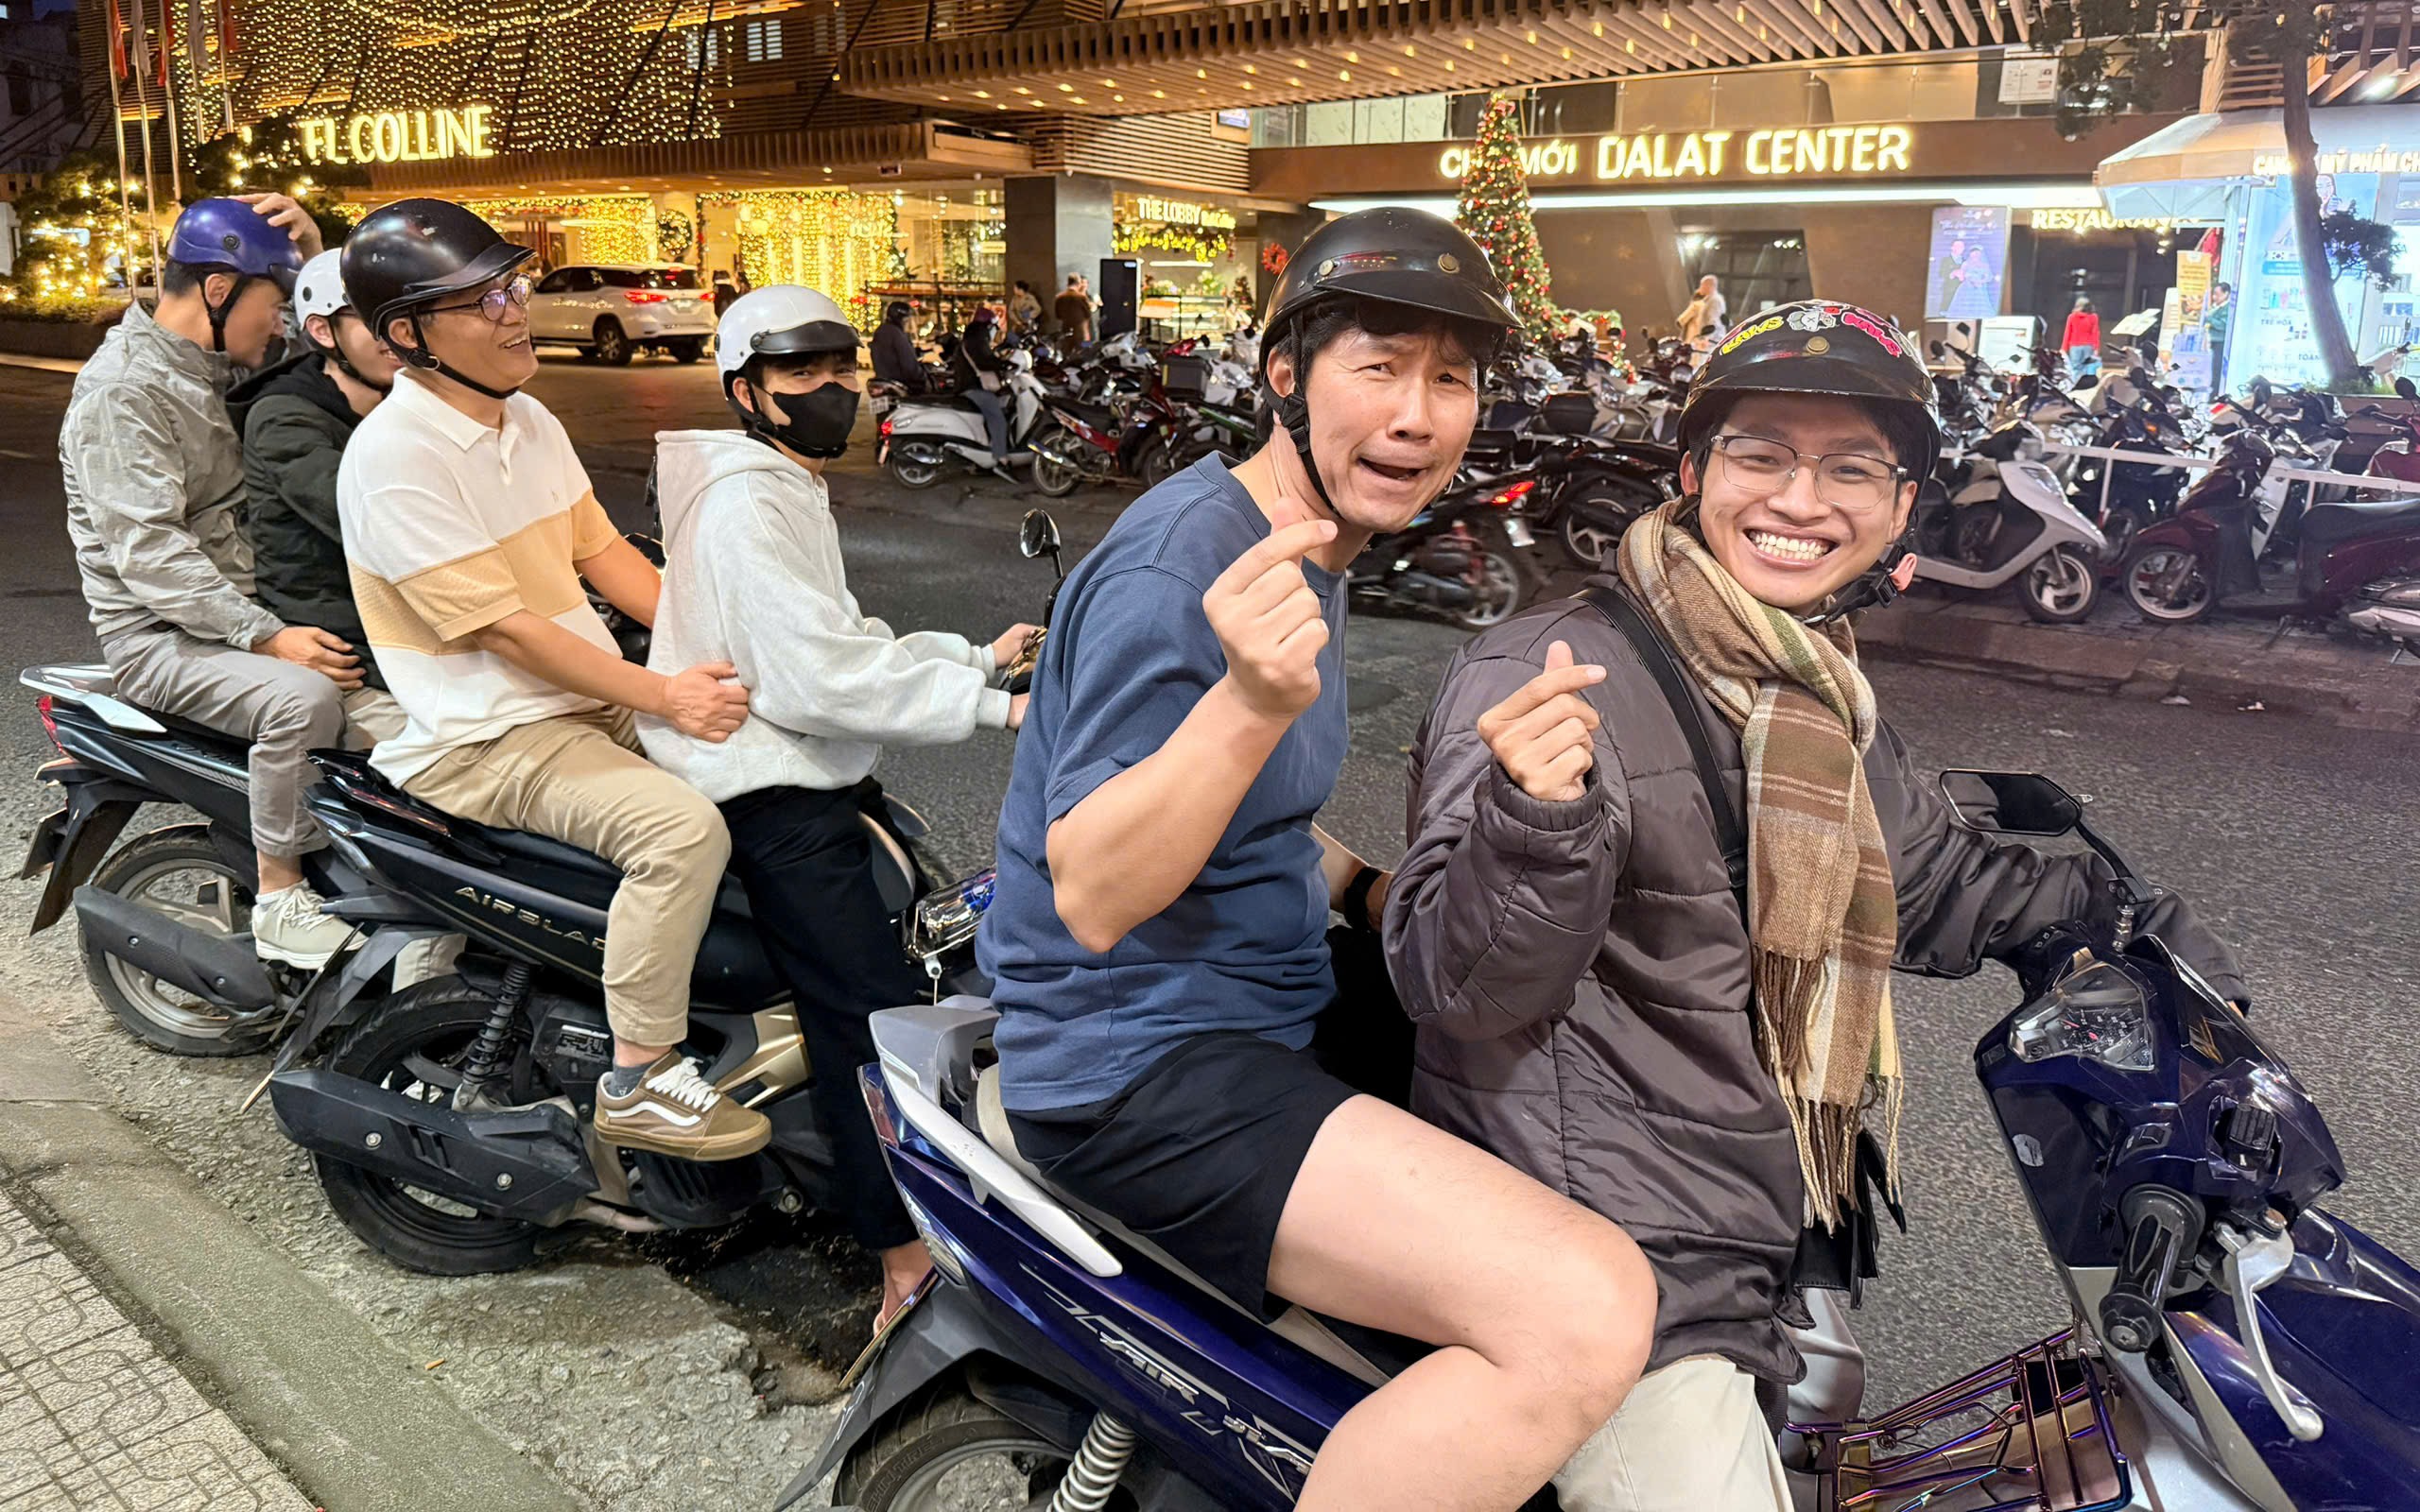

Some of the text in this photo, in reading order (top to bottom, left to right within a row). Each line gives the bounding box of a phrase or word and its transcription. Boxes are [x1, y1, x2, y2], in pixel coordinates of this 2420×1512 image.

[350, 105, 494, 163] COLLINE
[1598, 132, 1732, 179] DALAT
[1746, 127, 1911, 174] CENTER
[1137, 198, 1163, 220] THE
[1164, 201, 1201, 225] LOBBY
